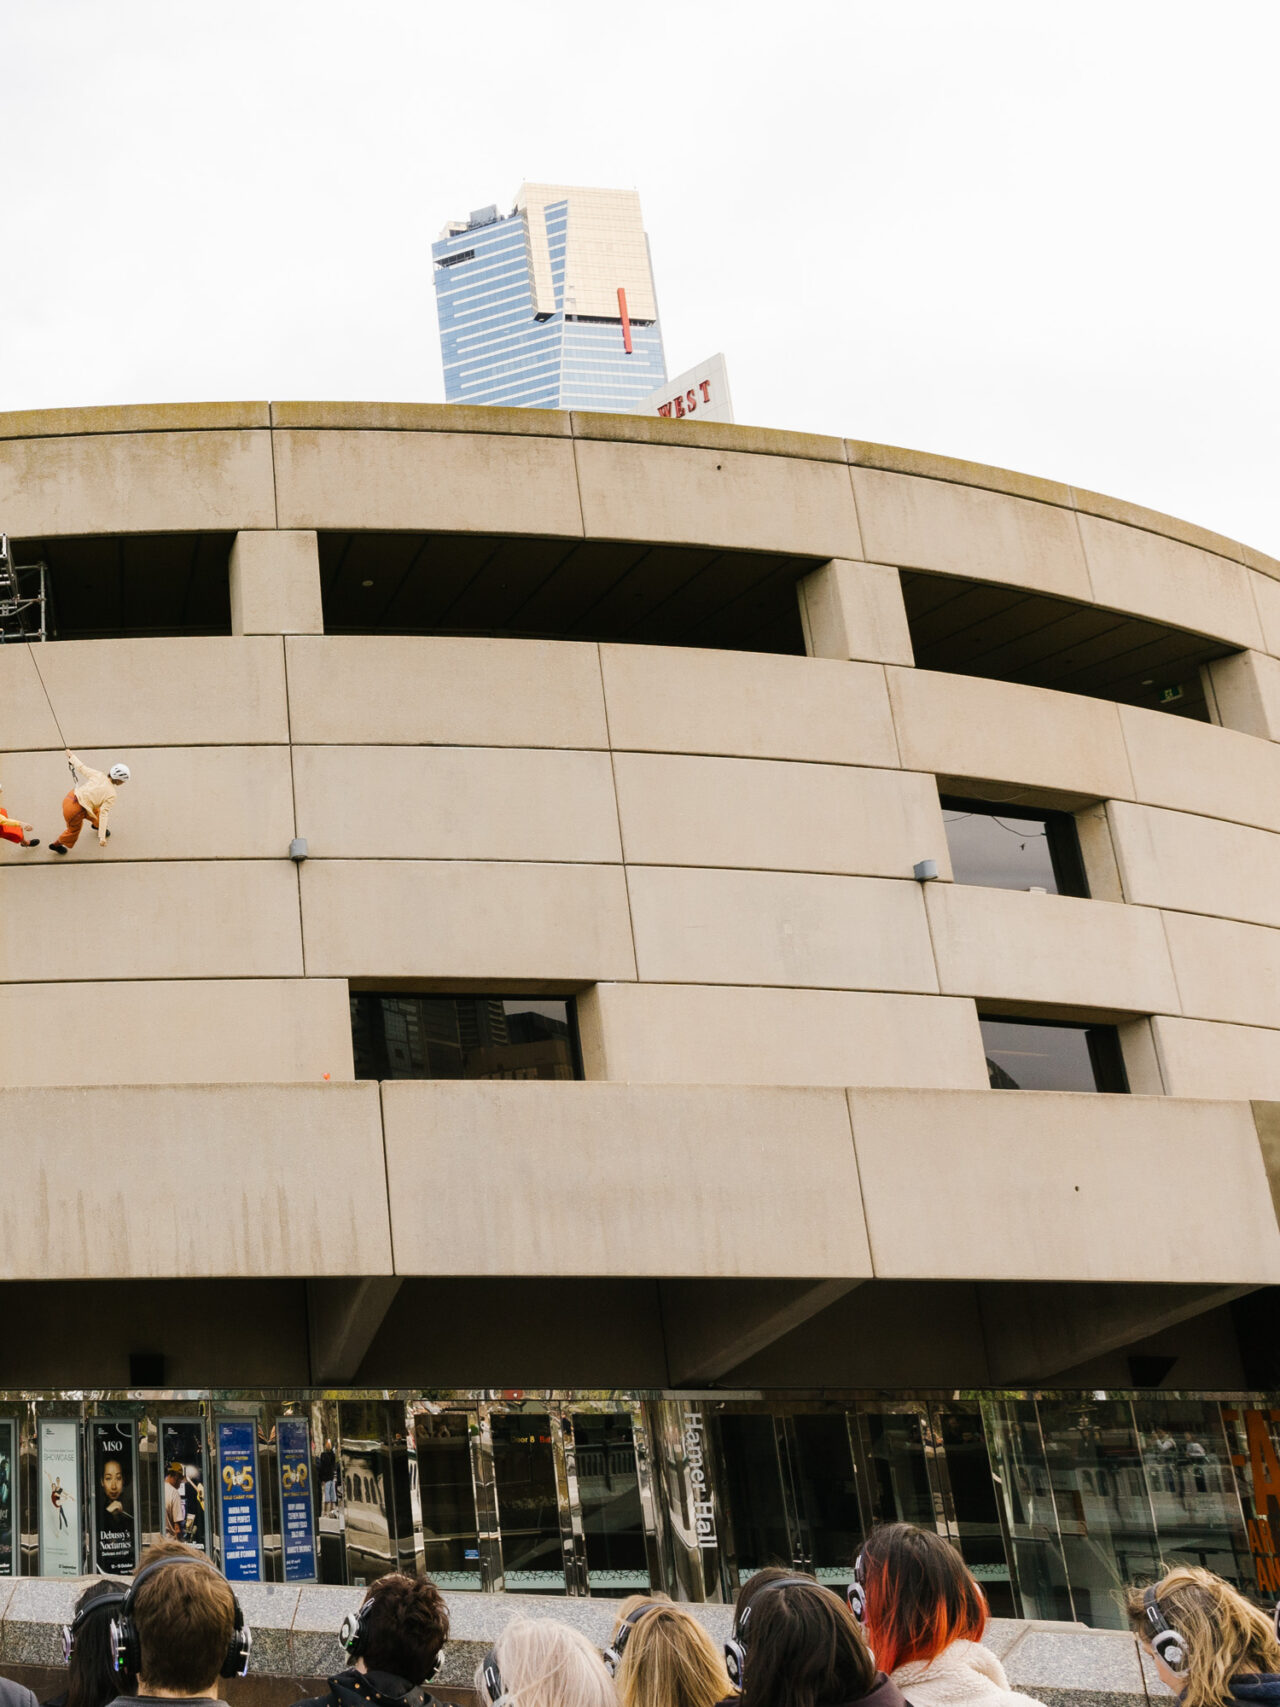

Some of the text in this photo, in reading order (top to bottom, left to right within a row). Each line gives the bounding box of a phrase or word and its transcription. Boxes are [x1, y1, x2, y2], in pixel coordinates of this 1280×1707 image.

[657, 380, 710, 418] WEST
[102, 1440, 123, 1452] MSO
[222, 1465, 235, 1492] 9
[241, 1465, 254, 1492] 5
[685, 1412, 718, 1549] Hamer Hall
[100, 1529, 131, 1541] Debussy's
[100, 1541, 132, 1550] Nocturnes
